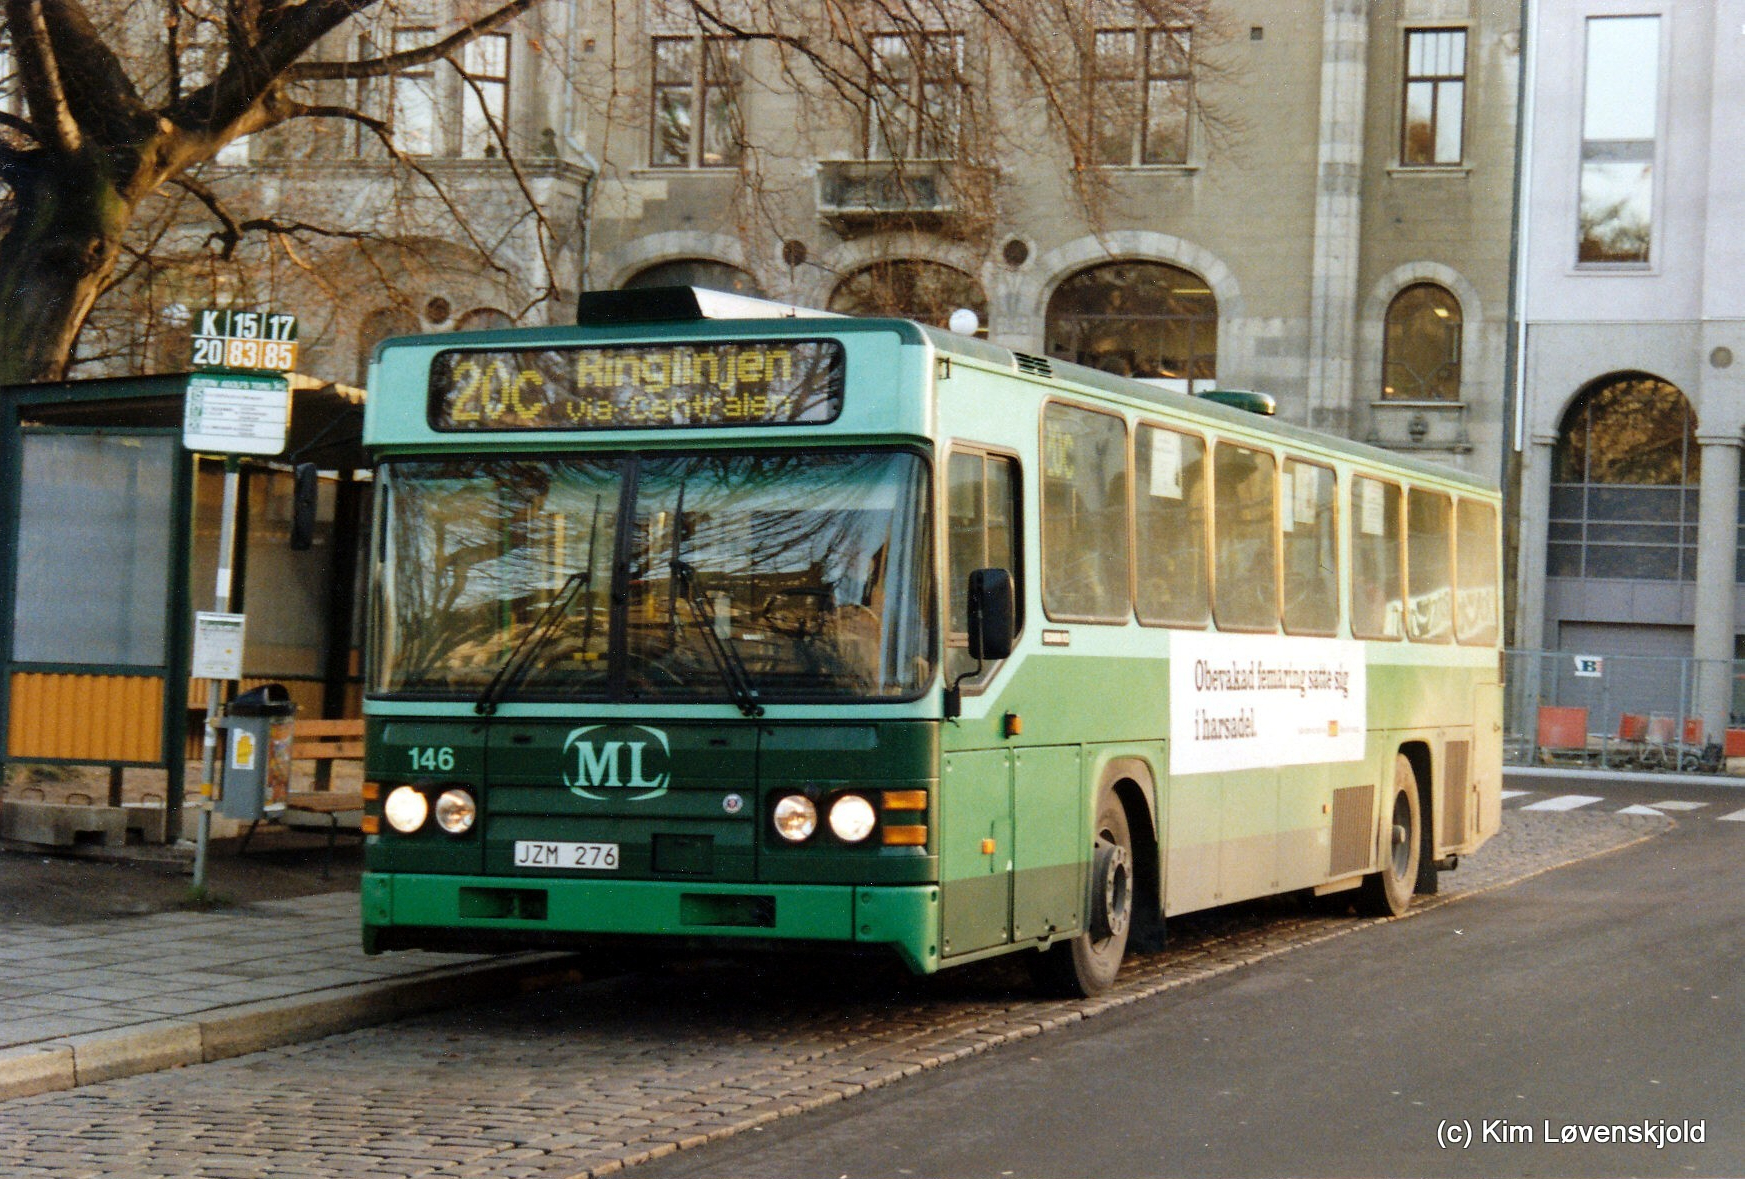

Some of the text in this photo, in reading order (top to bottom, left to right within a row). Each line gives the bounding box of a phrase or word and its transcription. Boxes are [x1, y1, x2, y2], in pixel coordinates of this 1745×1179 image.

[202, 310, 296, 341] K 15 17
[192, 338, 293, 370] 20 83 85
[577, 349, 792, 393] Ringlinjen
[452, 360, 543, 420] 20C
[629, 392, 791, 419] Centralen
[1194, 658, 1255, 692] Obevakad
[1333, 661, 1349, 698] sig
[1194, 708, 1200, 741] i
[408, 746, 455, 772] 146
[574, 740, 666, 788] ML
[518, 844, 617, 867] JZM 276
